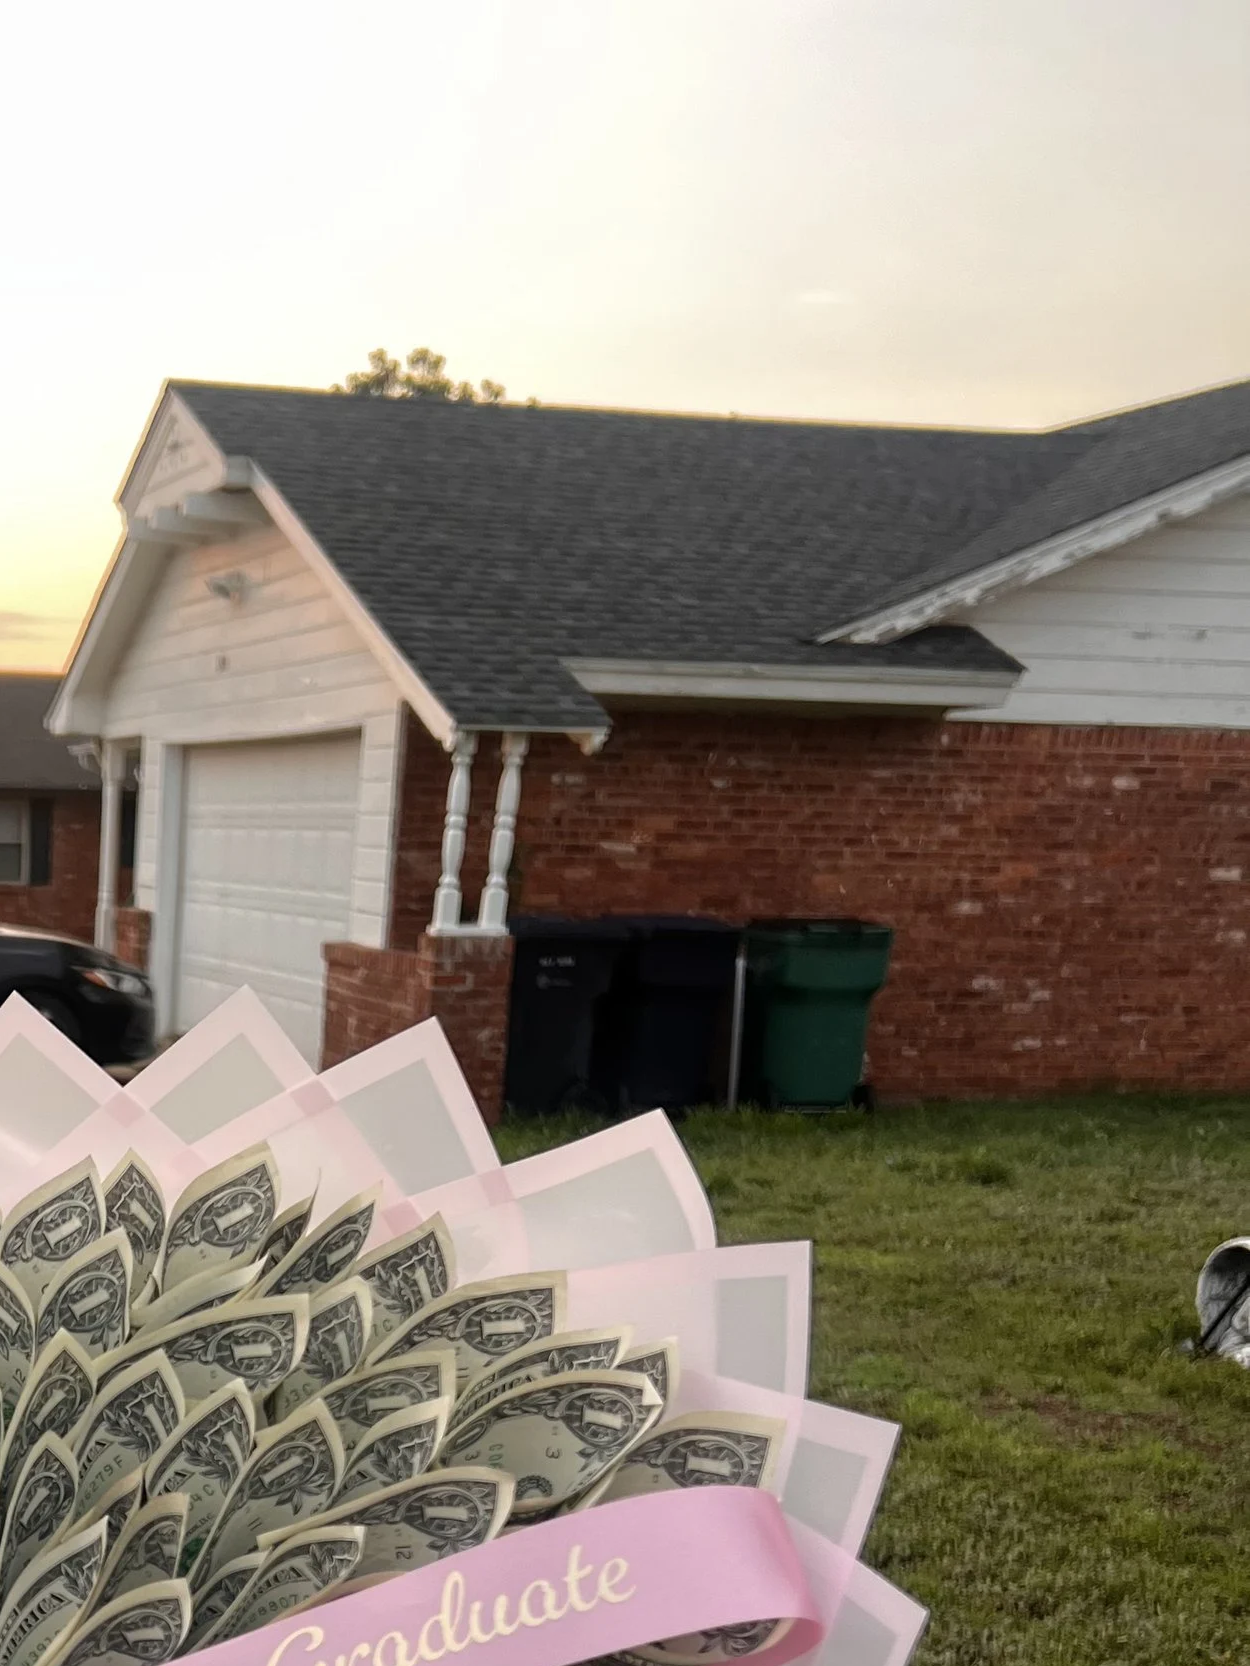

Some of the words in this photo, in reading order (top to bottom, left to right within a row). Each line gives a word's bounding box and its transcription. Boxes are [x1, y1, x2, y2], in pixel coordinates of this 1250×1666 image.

[130, 1200, 157, 1232] 1
[212, 1202, 255, 1235] 1
[42, 1216, 83, 1249] 1
[415, 1266, 433, 1299] 1
[69, 1288, 110, 1323] 1
[480, 1317, 526, 1338] 1
[229, 1342, 274, 1361] 1
[14, 1368, 26, 1387] 12
[33, 1388, 68, 1429] 1
[366, 1398, 411, 1413] 1
[582, 1405, 623, 1430] 1
[545, 1447, 561, 1461] 3
[686, 1454, 734, 1475] 1
[259, 1456, 302, 1488] 1
[18, 1486, 50, 1527] 1
[422, 1505, 469, 1522] 1
[396, 1545, 413, 1560] 12
[120, 1627, 166, 1643] 1
